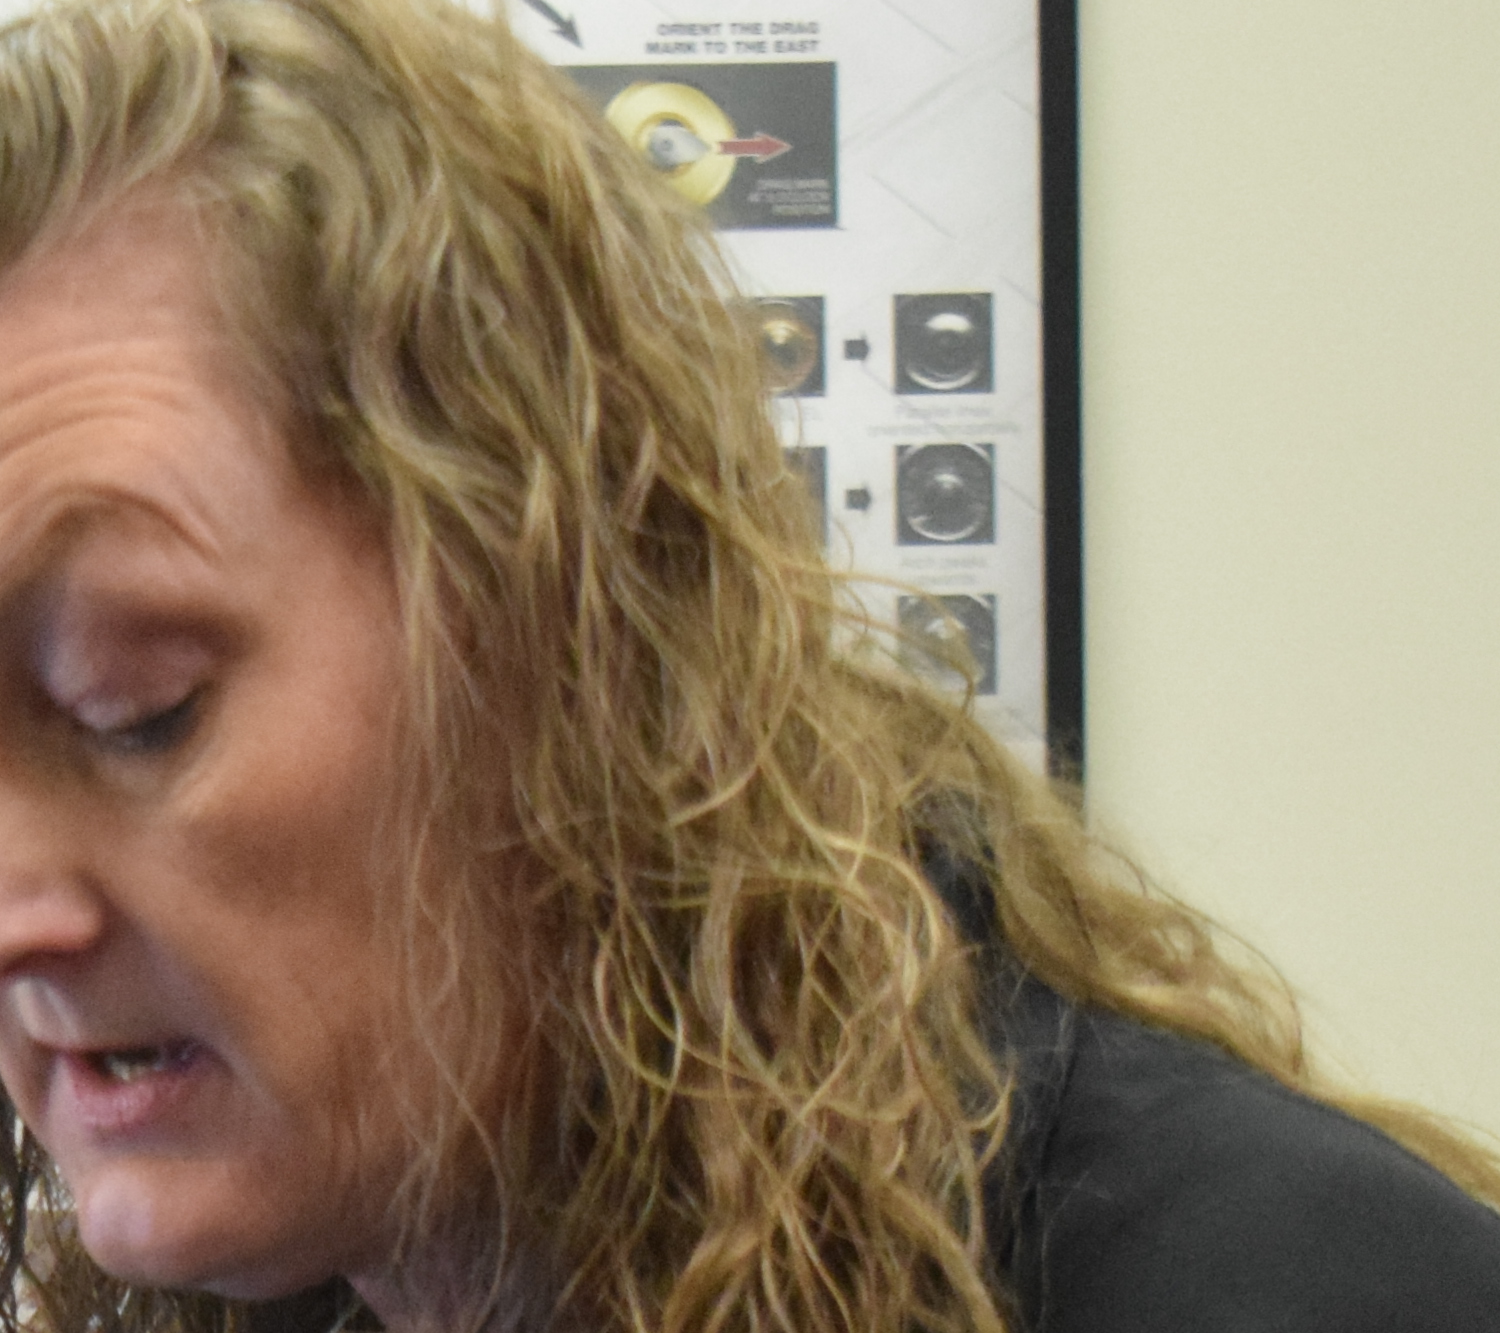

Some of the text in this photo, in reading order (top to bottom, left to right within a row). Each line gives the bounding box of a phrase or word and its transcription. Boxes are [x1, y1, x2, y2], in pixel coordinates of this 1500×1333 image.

[729, 22, 763, 35] THE
[645, 39, 820, 54] MARK TO THE EAST
